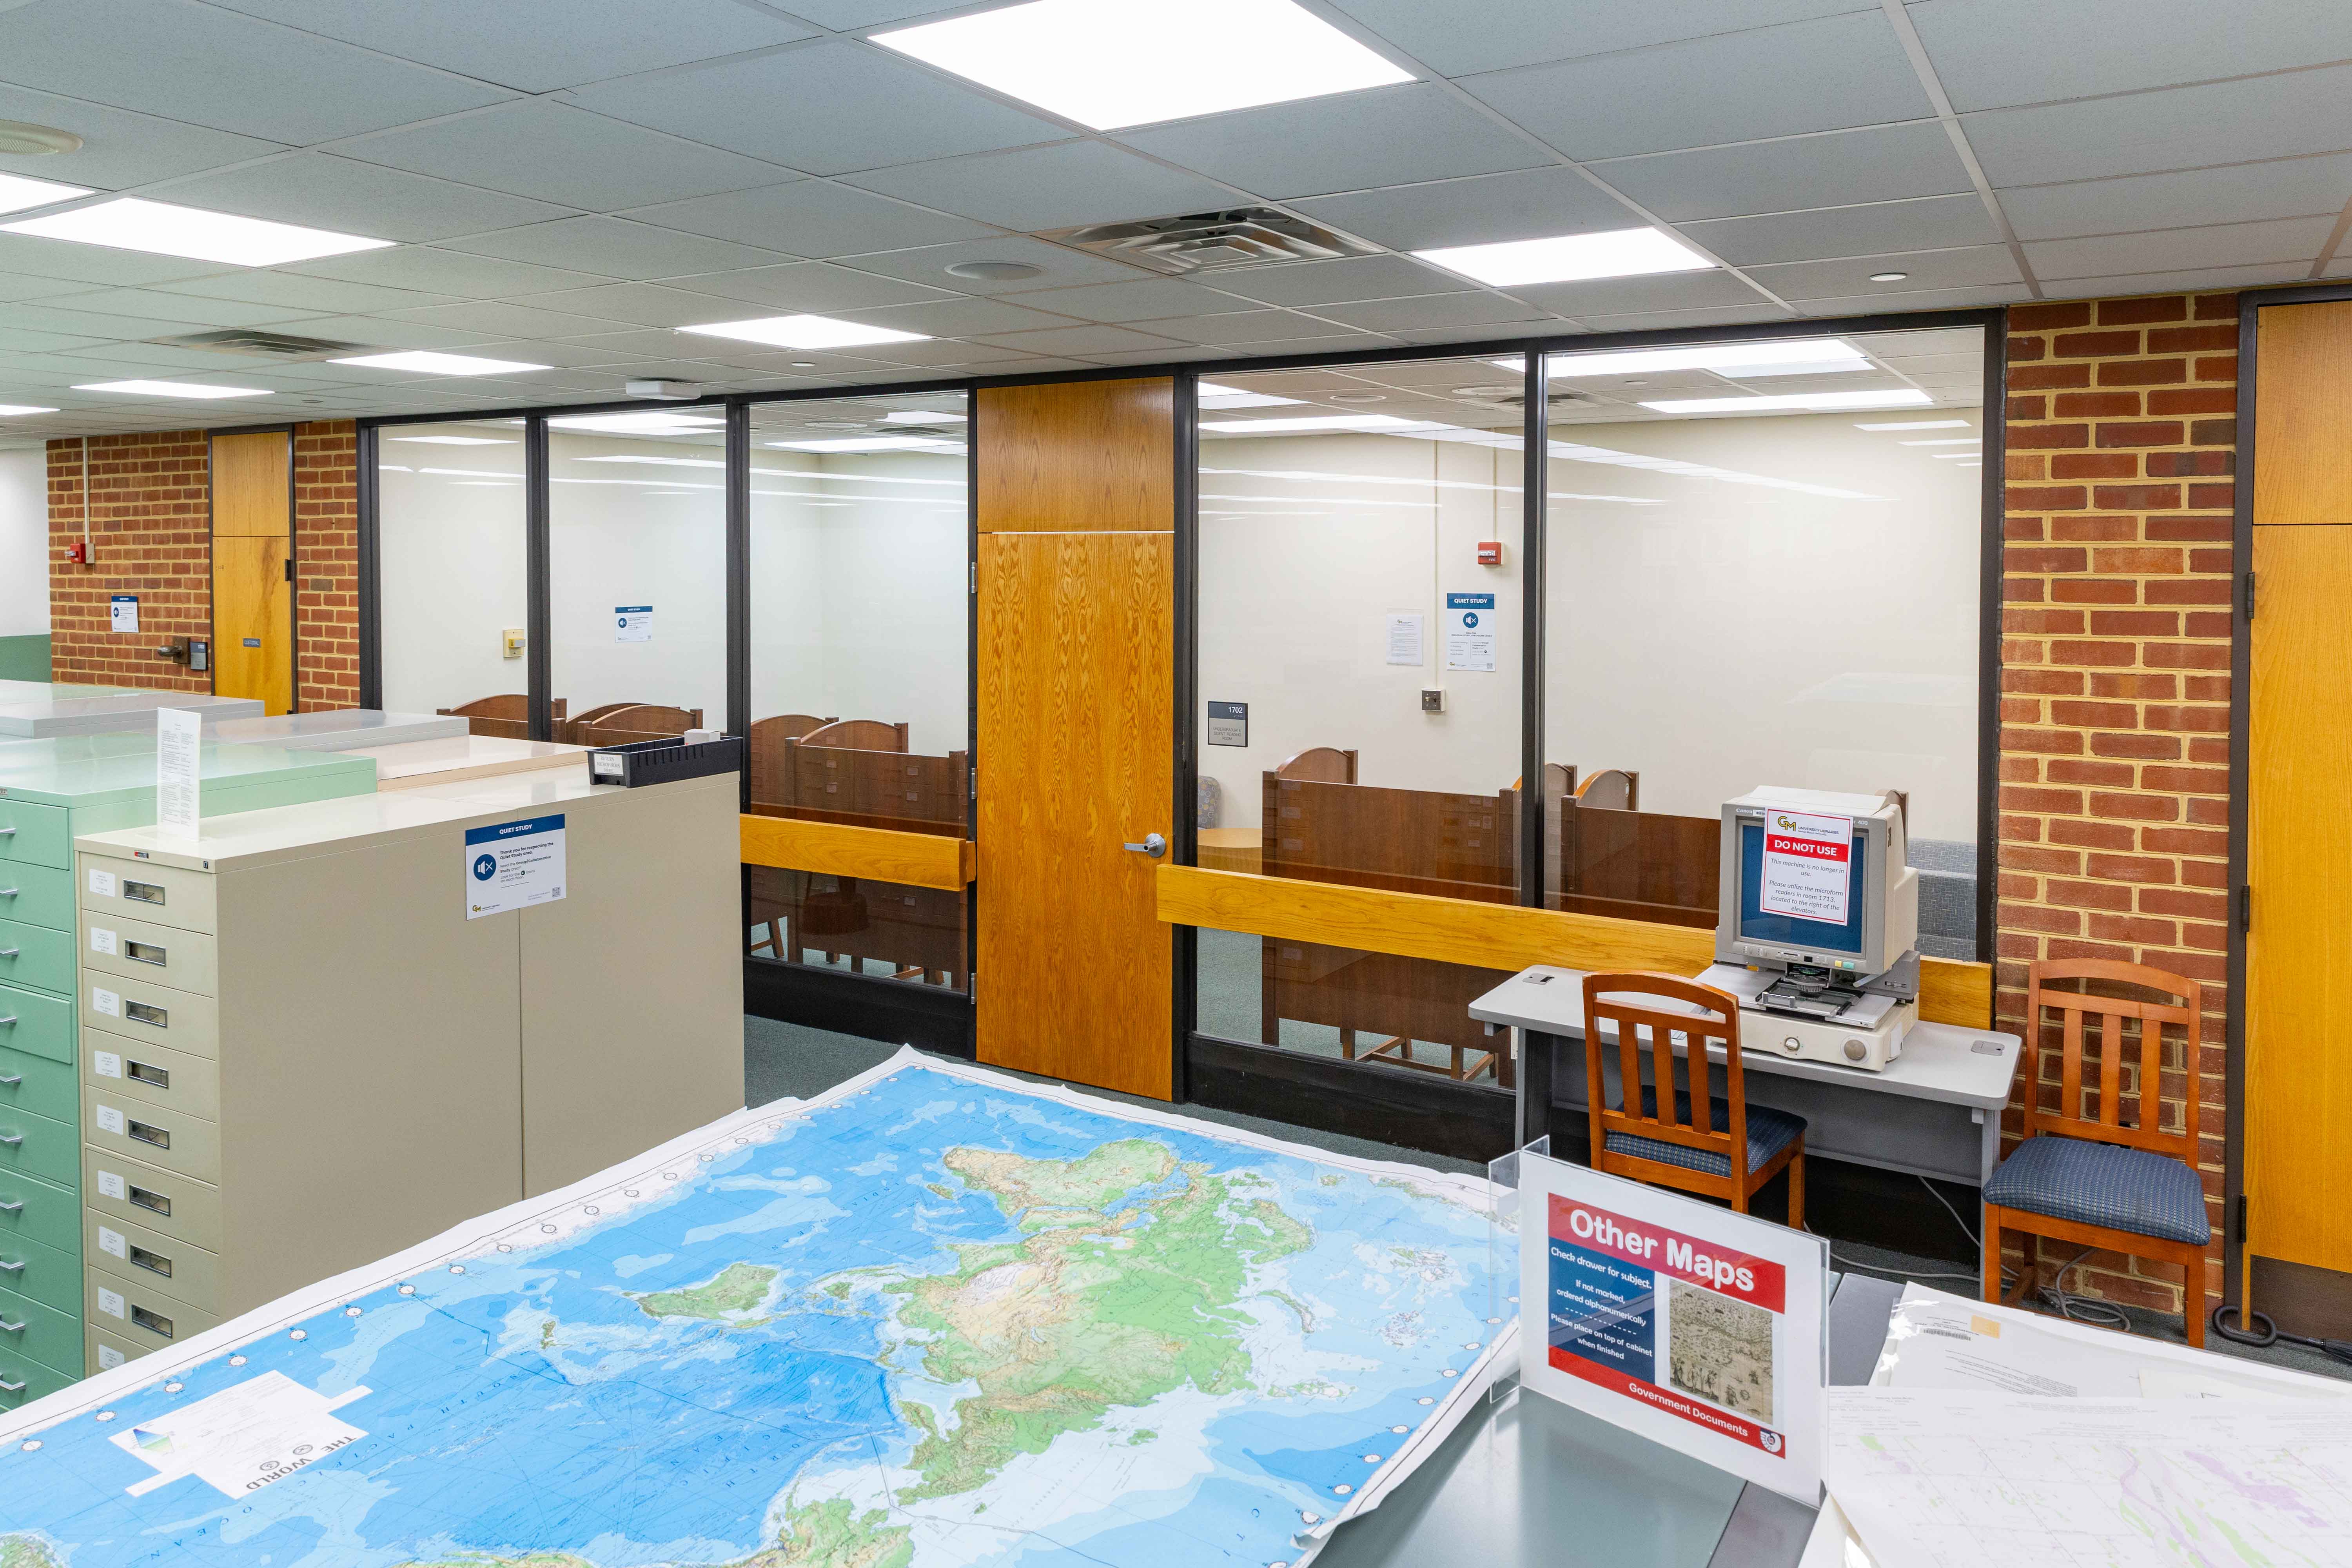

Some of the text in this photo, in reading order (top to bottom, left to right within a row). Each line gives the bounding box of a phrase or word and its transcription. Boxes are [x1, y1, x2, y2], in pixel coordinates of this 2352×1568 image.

[1778, 816, 1796, 831] GM
[516, 856, 552, 865] Group/Collaborative
[1775, 839, 1837, 856] DO NOT USE
[1815, 888, 1843, 896] microform
[1791, 906, 1817, 915] elevators.
[1570, 1209, 1755, 1292] Other Maps
[1551, 1247, 1652, 1289] Check drawer for subject.
[1575, 1279, 1625, 1304] If not marked,
[1556, 1289, 1646, 1327] ordered alphanumerically
[1551, 1313, 1573, 1327] Please
[1574, 1323, 1593, 1335] place
[1604, 1334, 1616, 1344] top
[1626, 1341, 1653, 1357] cabinet
[1577, 1337, 1624, 1359] when finished
[1629, 1383, 1748, 1437] Government Documents
[246, 1435, 356, 1490] THE WORLD
[150, 1506, 252, 1560] OCEAN
